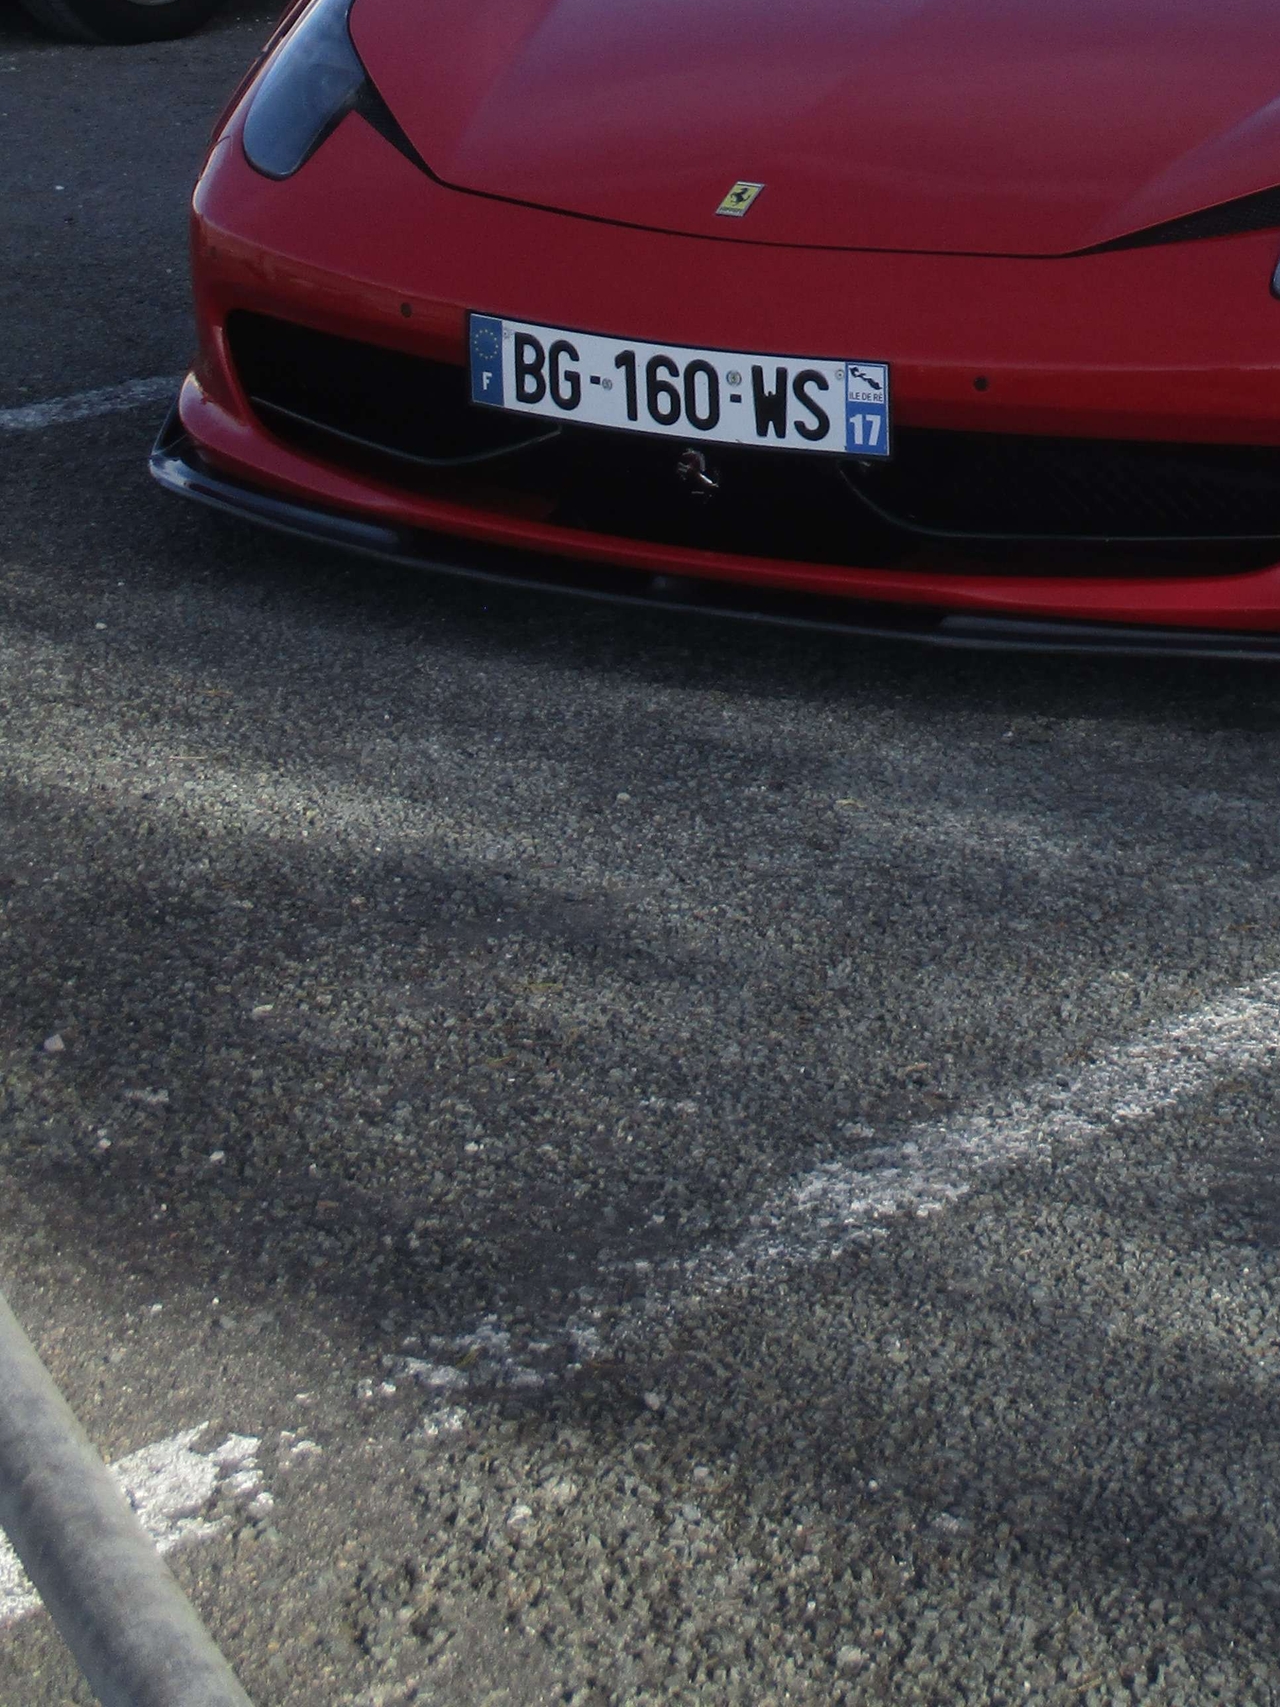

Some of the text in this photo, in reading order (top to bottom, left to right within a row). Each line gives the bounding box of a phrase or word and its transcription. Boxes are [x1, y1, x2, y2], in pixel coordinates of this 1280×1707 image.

[482, 371, 492, 390] F
[514, 331, 830, 441] BG-160-WS
[862, 393, 872, 401] DE
[849, 413, 881, 446] 17
